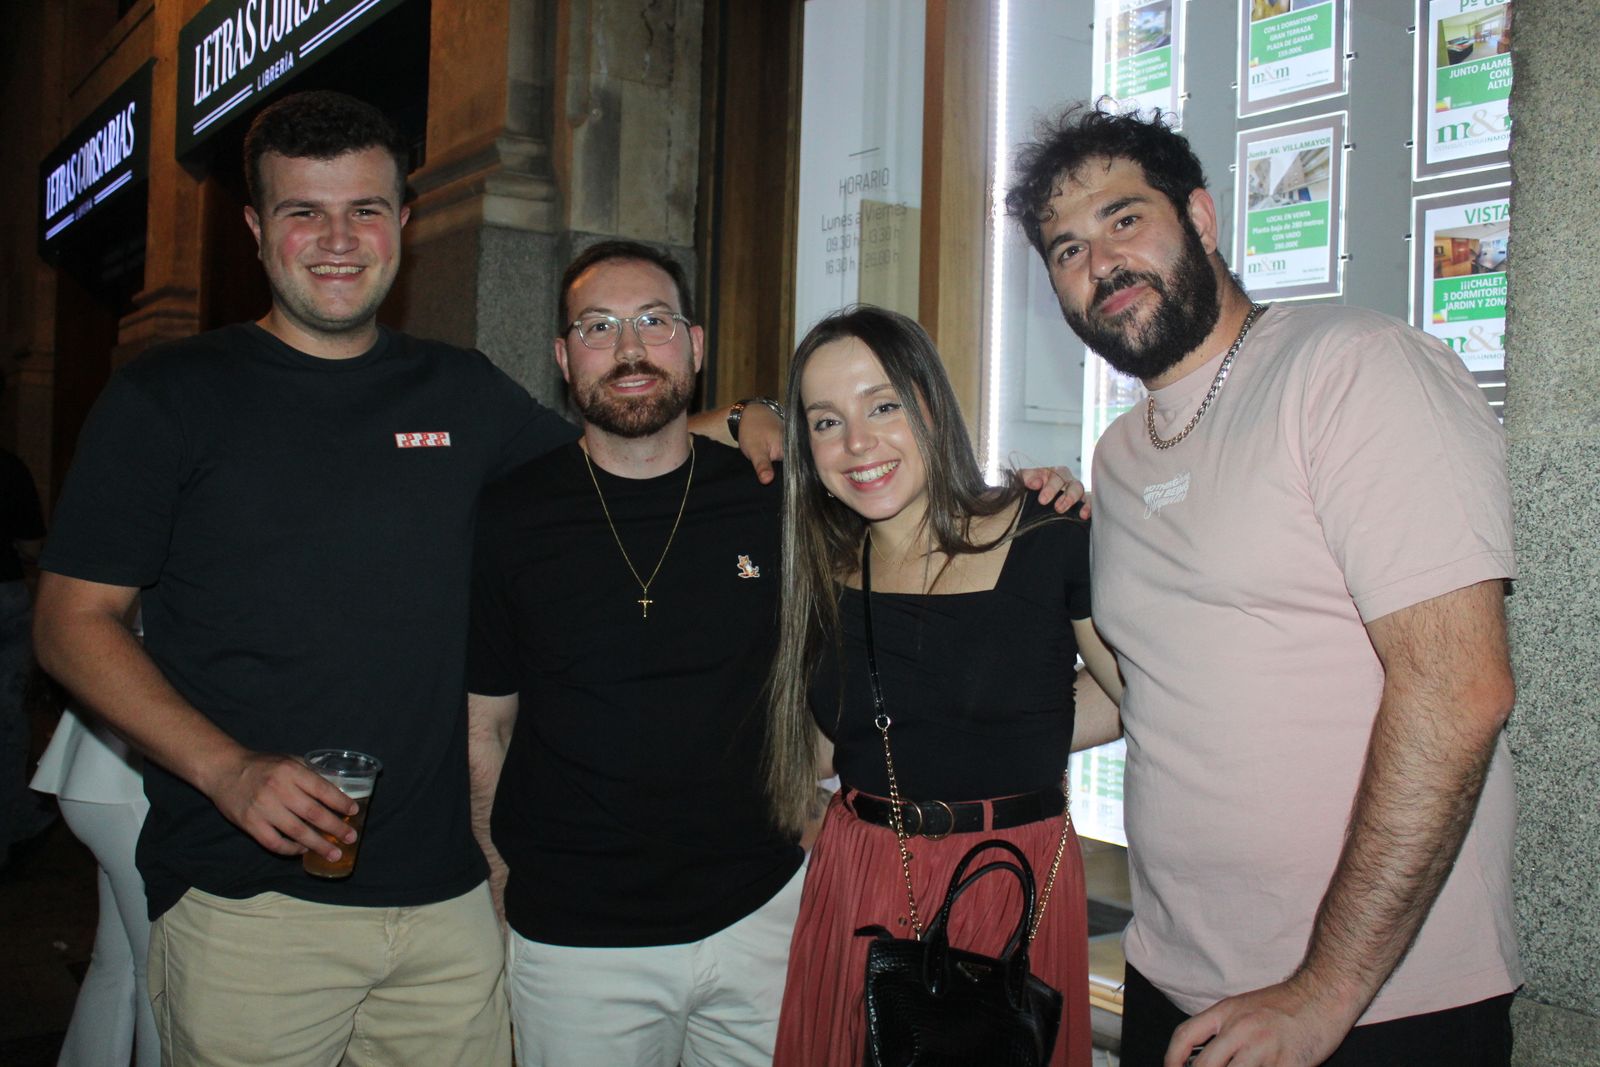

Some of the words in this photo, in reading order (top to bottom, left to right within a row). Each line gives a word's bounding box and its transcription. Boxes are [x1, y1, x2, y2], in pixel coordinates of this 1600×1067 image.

[193, 0, 257, 106] LETRAS
[257, 51, 295, 91] LIBRERÍA
[1251, 65, 1290, 85] m&m
[1449, 65, 1479, 79] JUNTO
[1489, 69, 1510, 79] CON
[77, 101, 136, 194] CORSARIAS
[1282, 136, 1331, 152] VILLAMAYOR
[839, 168, 890, 196] HORARIO
[821, 214, 853, 232] Lunes
[865, 201, 908, 223] Viernes
[1248, 257, 1286, 274] m&m
[1443, 292, 1449, 302] 3
[1445, 300, 1476, 311] JARDIN
[1477, 299, 1484, 308] Y
